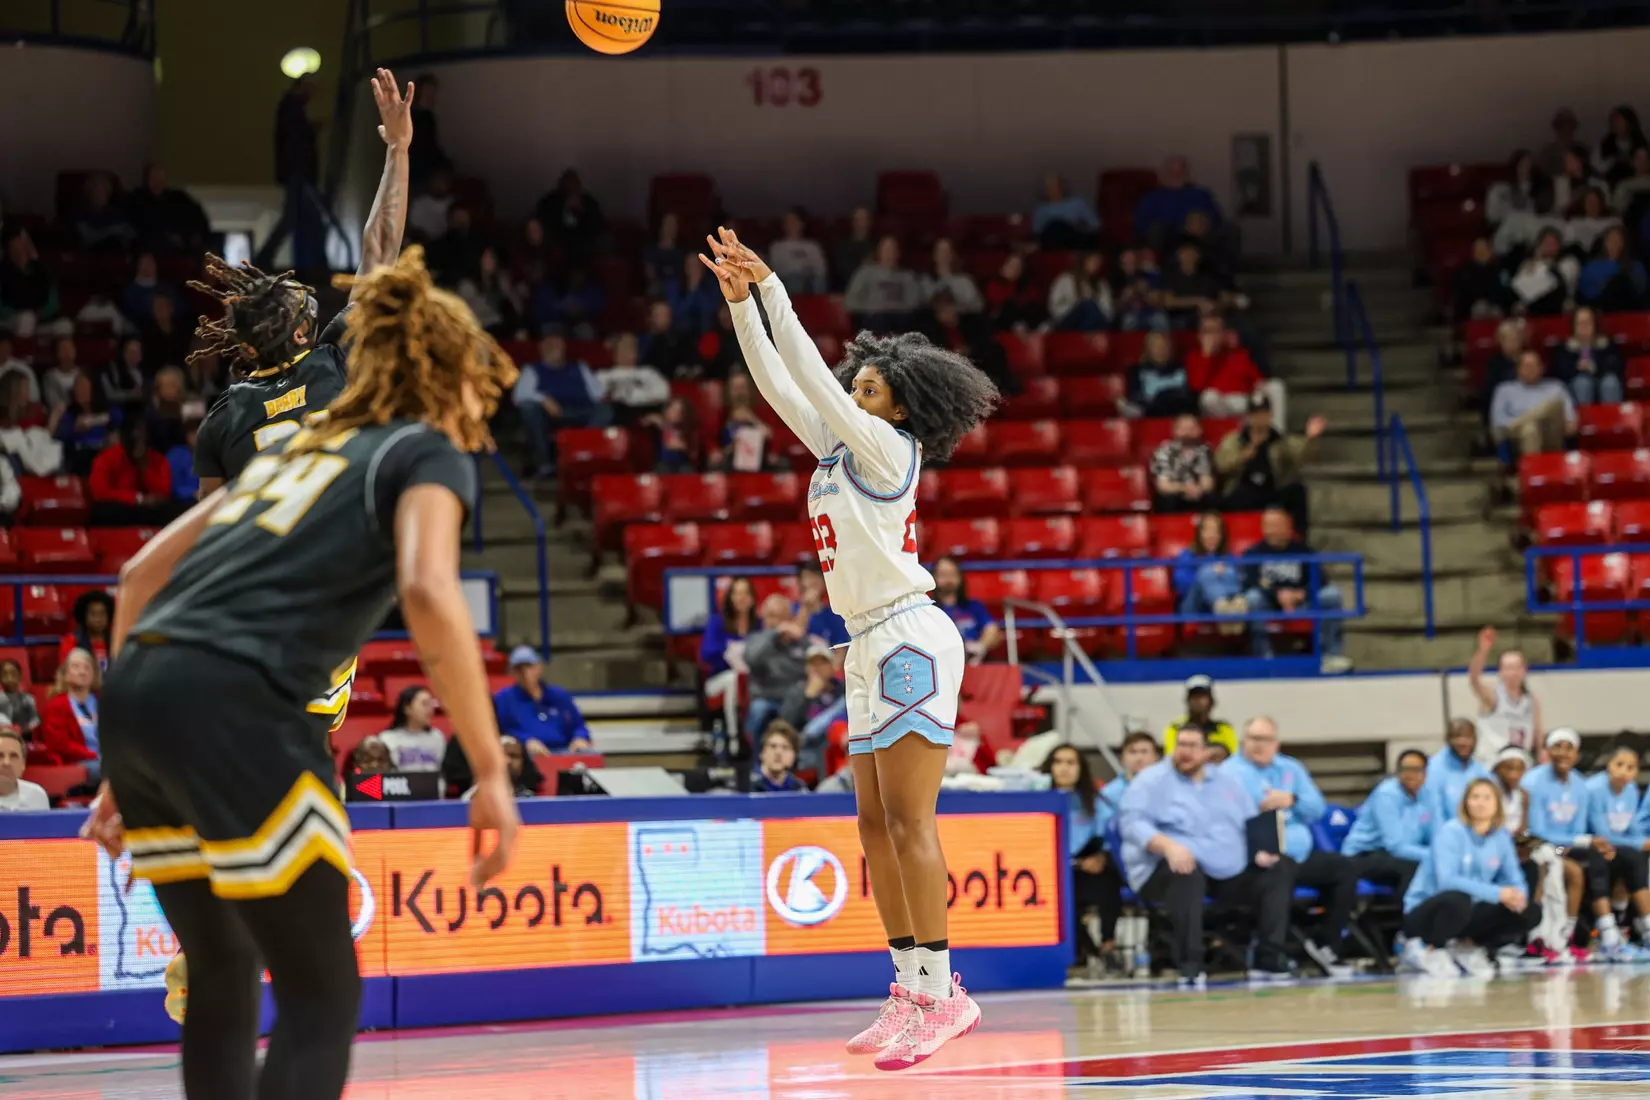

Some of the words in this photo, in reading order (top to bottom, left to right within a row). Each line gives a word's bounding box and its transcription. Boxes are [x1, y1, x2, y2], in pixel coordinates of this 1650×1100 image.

[595, 10, 653, 34] Wilson
[746, 66, 823, 108] 103
[207, 452, 349, 537] 24
[656, 904, 756, 936] Kubota
